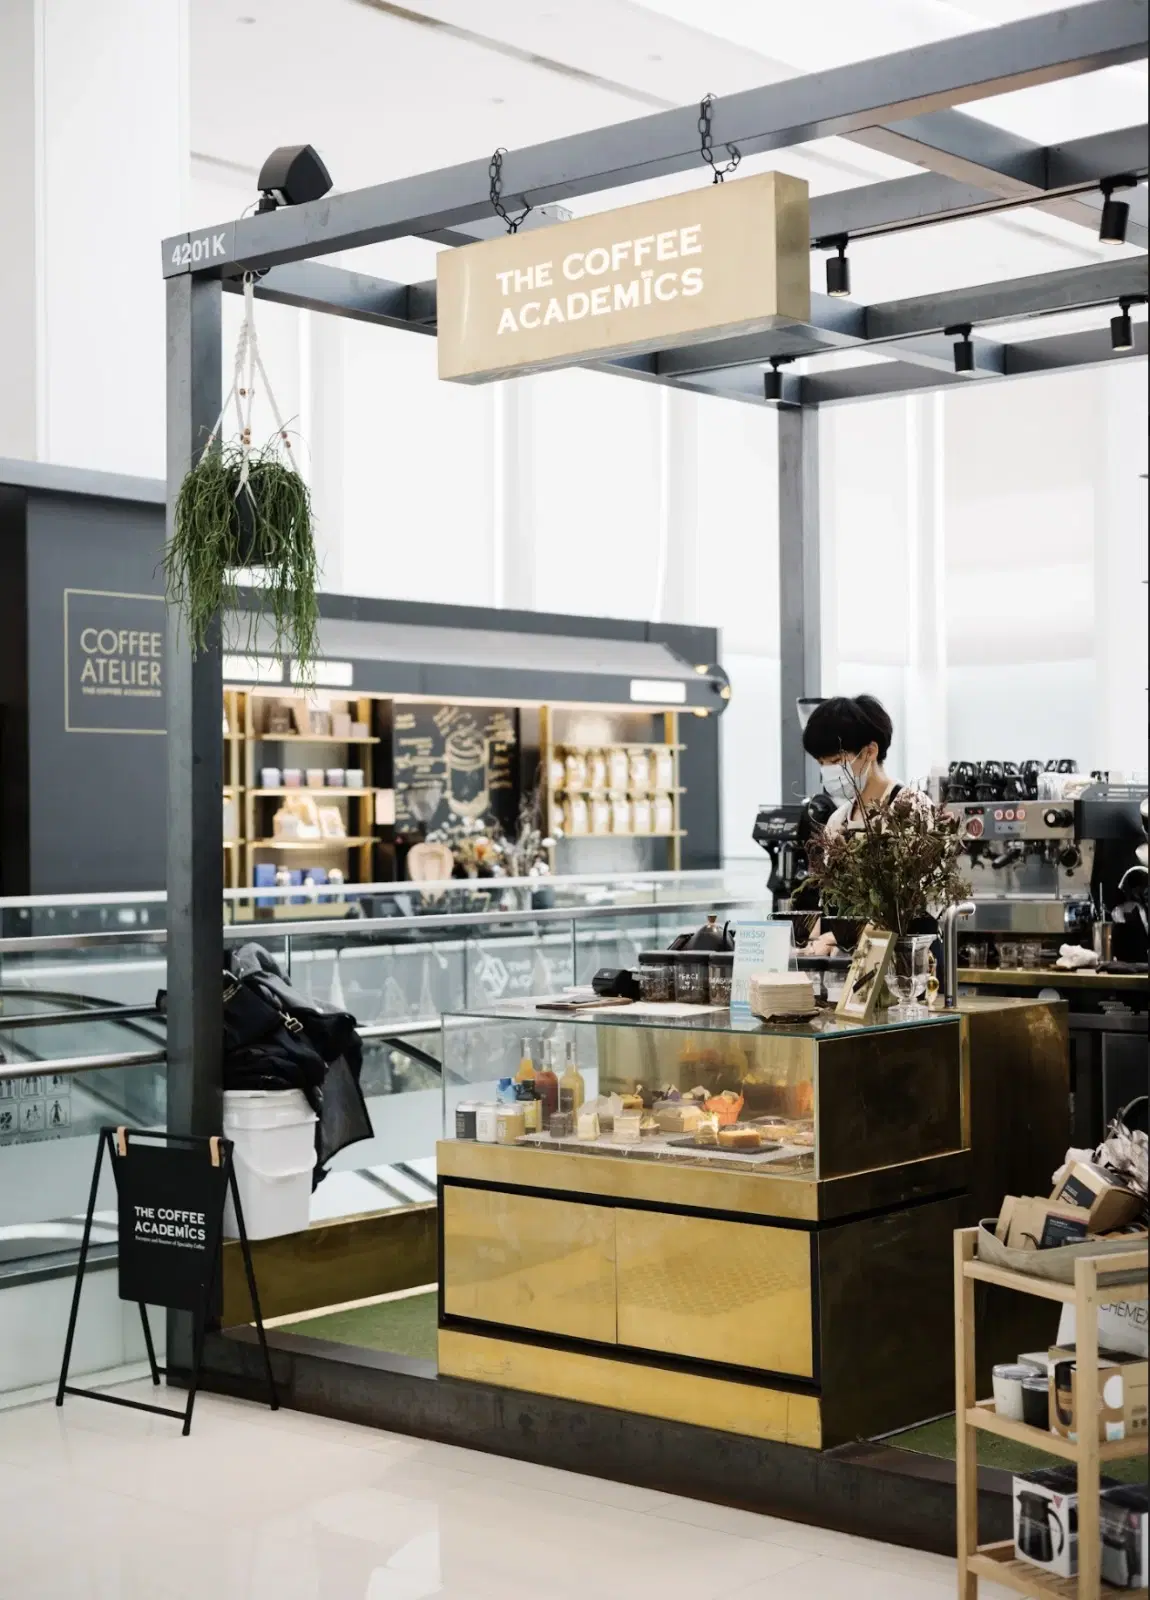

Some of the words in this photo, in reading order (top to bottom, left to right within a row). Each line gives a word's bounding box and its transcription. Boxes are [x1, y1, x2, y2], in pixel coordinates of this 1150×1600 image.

[171, 232, 226, 266] 4201K
[495, 260, 553, 296] THE
[562, 223, 703, 281] COFFEE
[80, 628, 162, 657] COFFEE
[80, 657, 161, 686] ATELIER
[134, 1206, 155, 1218] THE
[157, 1208, 205, 1224] COFFEE
